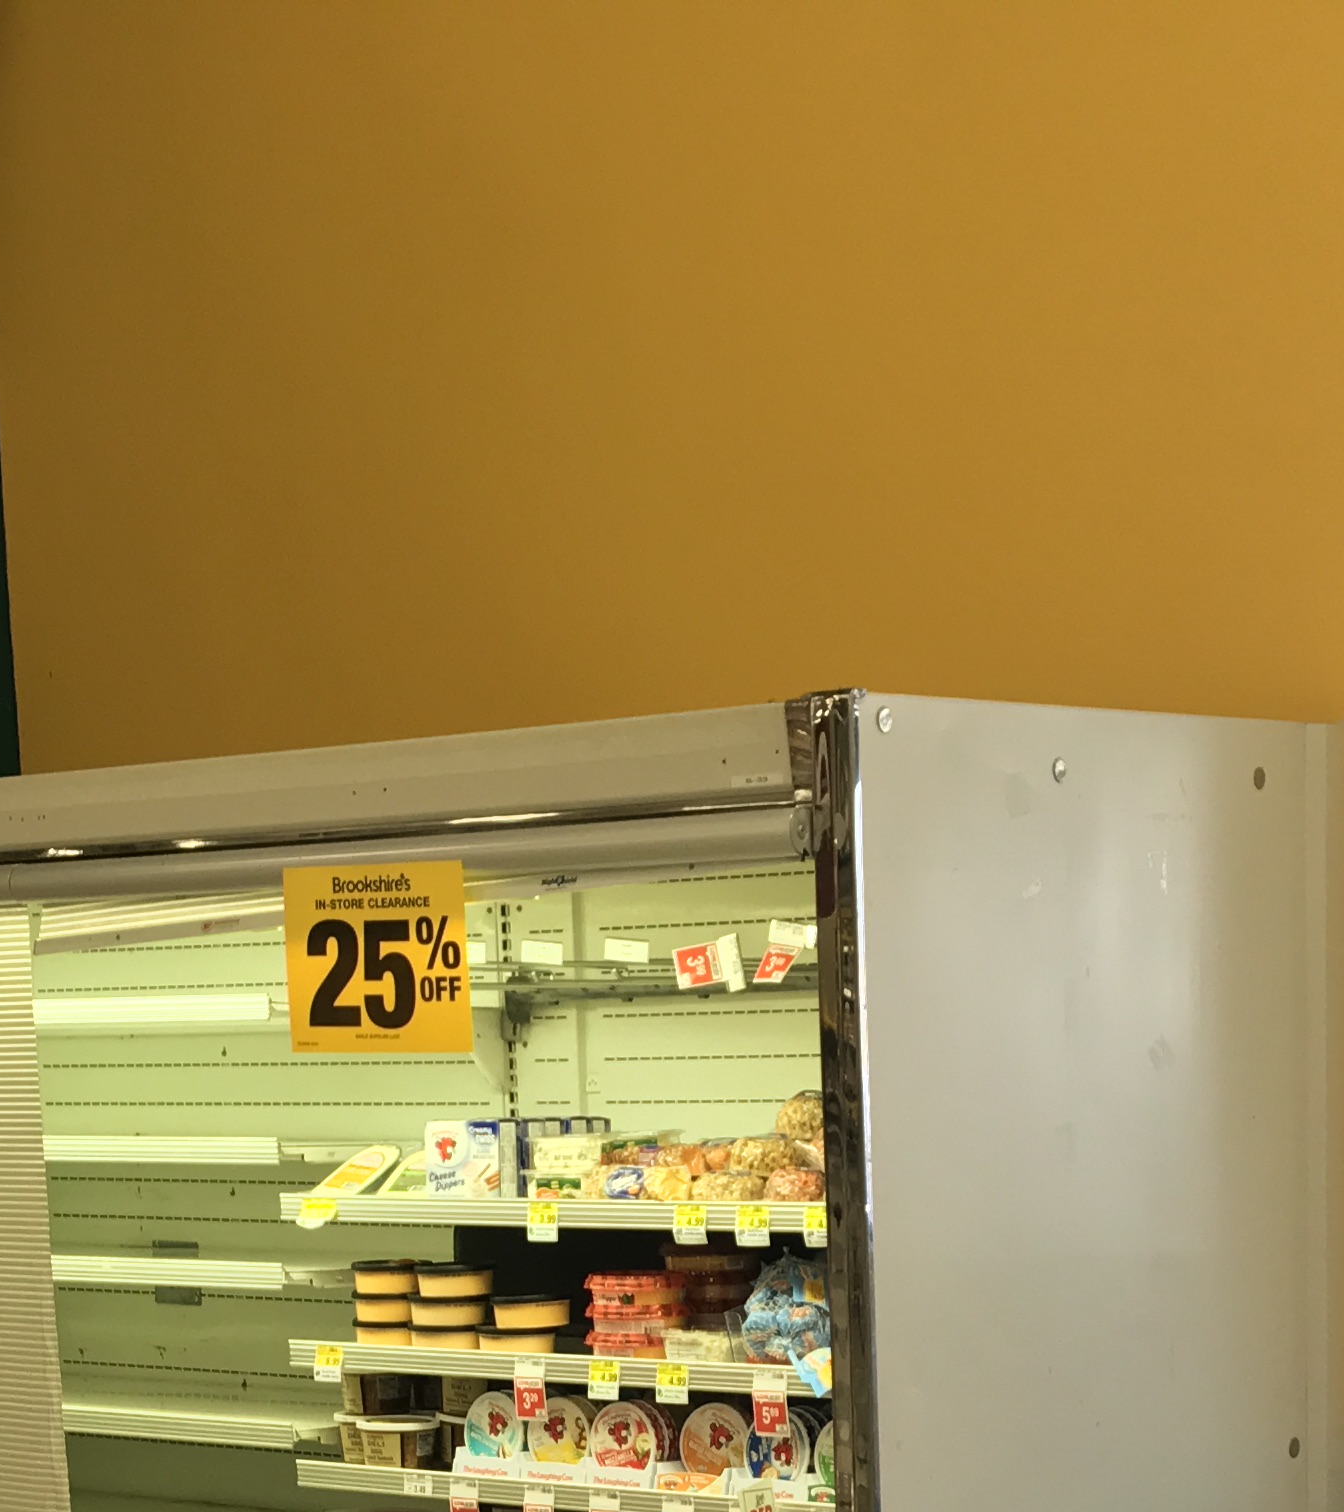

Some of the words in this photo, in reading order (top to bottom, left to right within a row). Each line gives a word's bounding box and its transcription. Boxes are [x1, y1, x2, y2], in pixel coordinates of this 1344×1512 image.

[332, 873, 411, 894] Brookshire's
[315, 899, 364, 910] IN-STORE
[367, 896, 430, 909] CLEARANCE
[306, 915, 462, 1030] 25%
[420, 976, 462, 1002] OFF
[429, 1170, 457, 1182] Cheese
[434, 1179, 466, 1193] Dippers
[686, 1217, 705, 1227] 4.99
[749, 1218, 768, 1228] 4.99
